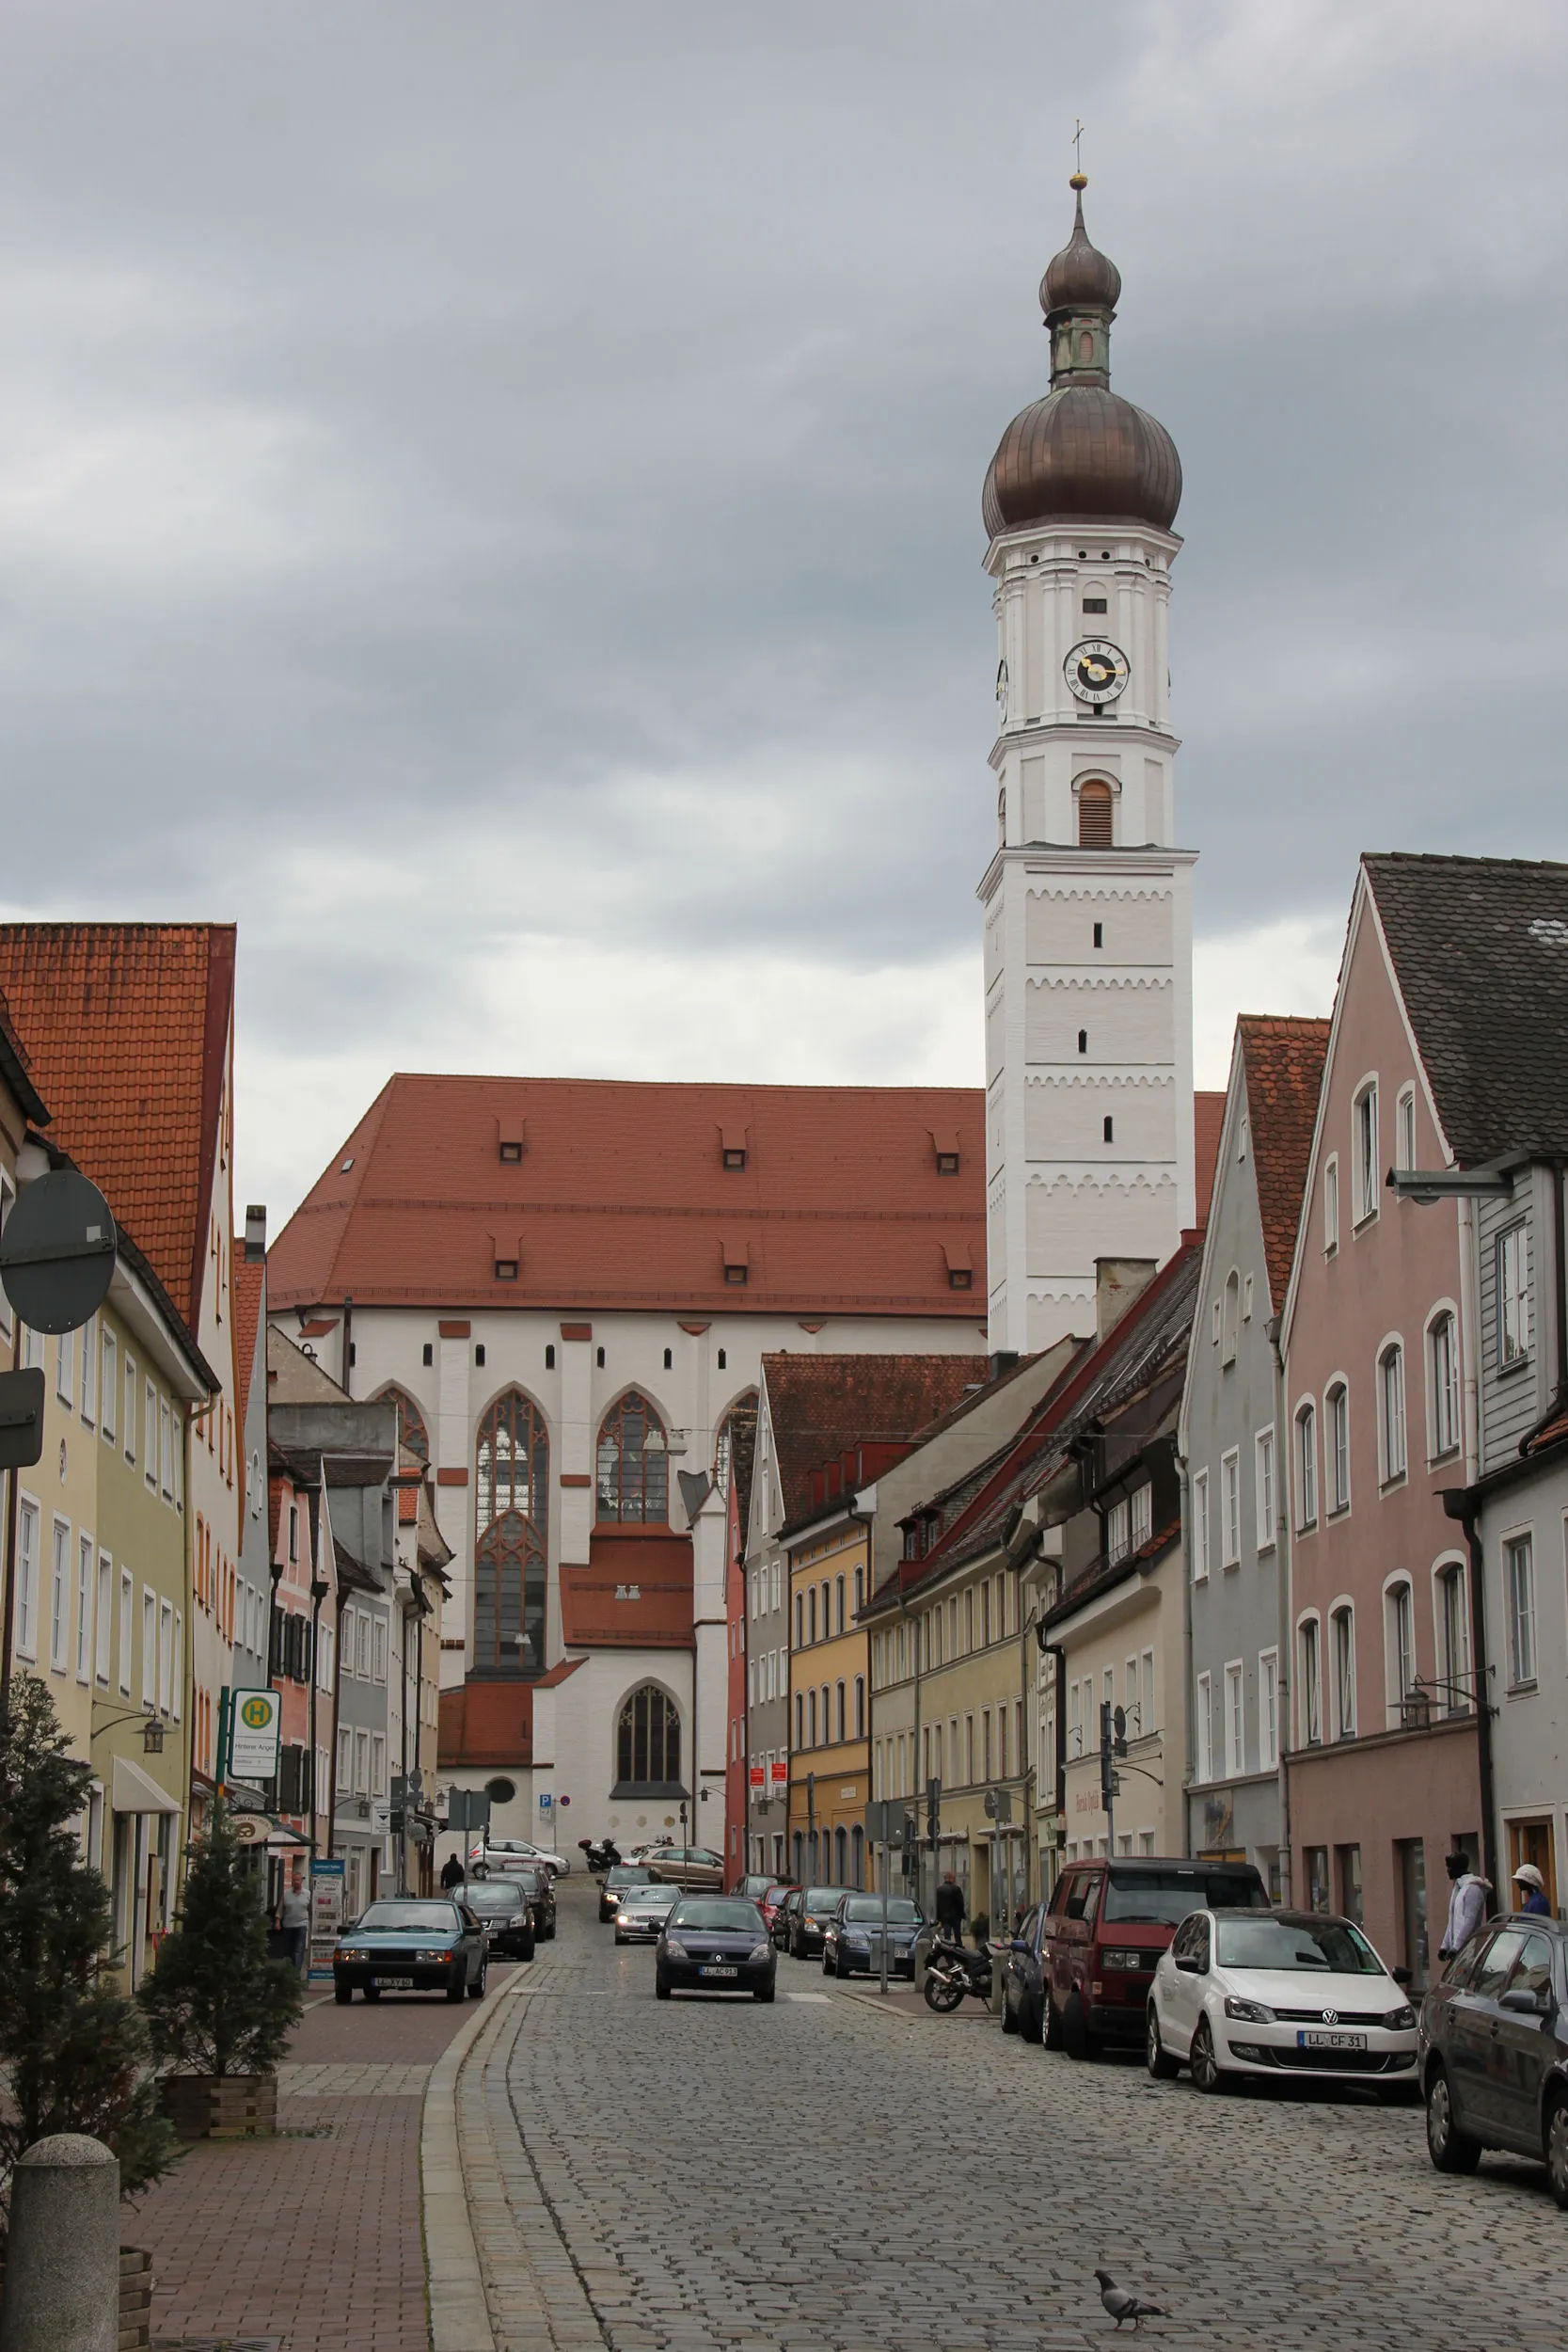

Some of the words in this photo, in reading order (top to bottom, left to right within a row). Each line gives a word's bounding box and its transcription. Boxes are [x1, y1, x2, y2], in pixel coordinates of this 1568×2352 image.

[1092, 644, 1101, 652] XII
[249, 1704, 264, 1722] H
[542, 1795, 549, 1806] P
[1308, 2033, 1323, 2045] LL
[1330, 2034, 1345, 2046] CF
[1347, 2035, 1362, 2047] 31
